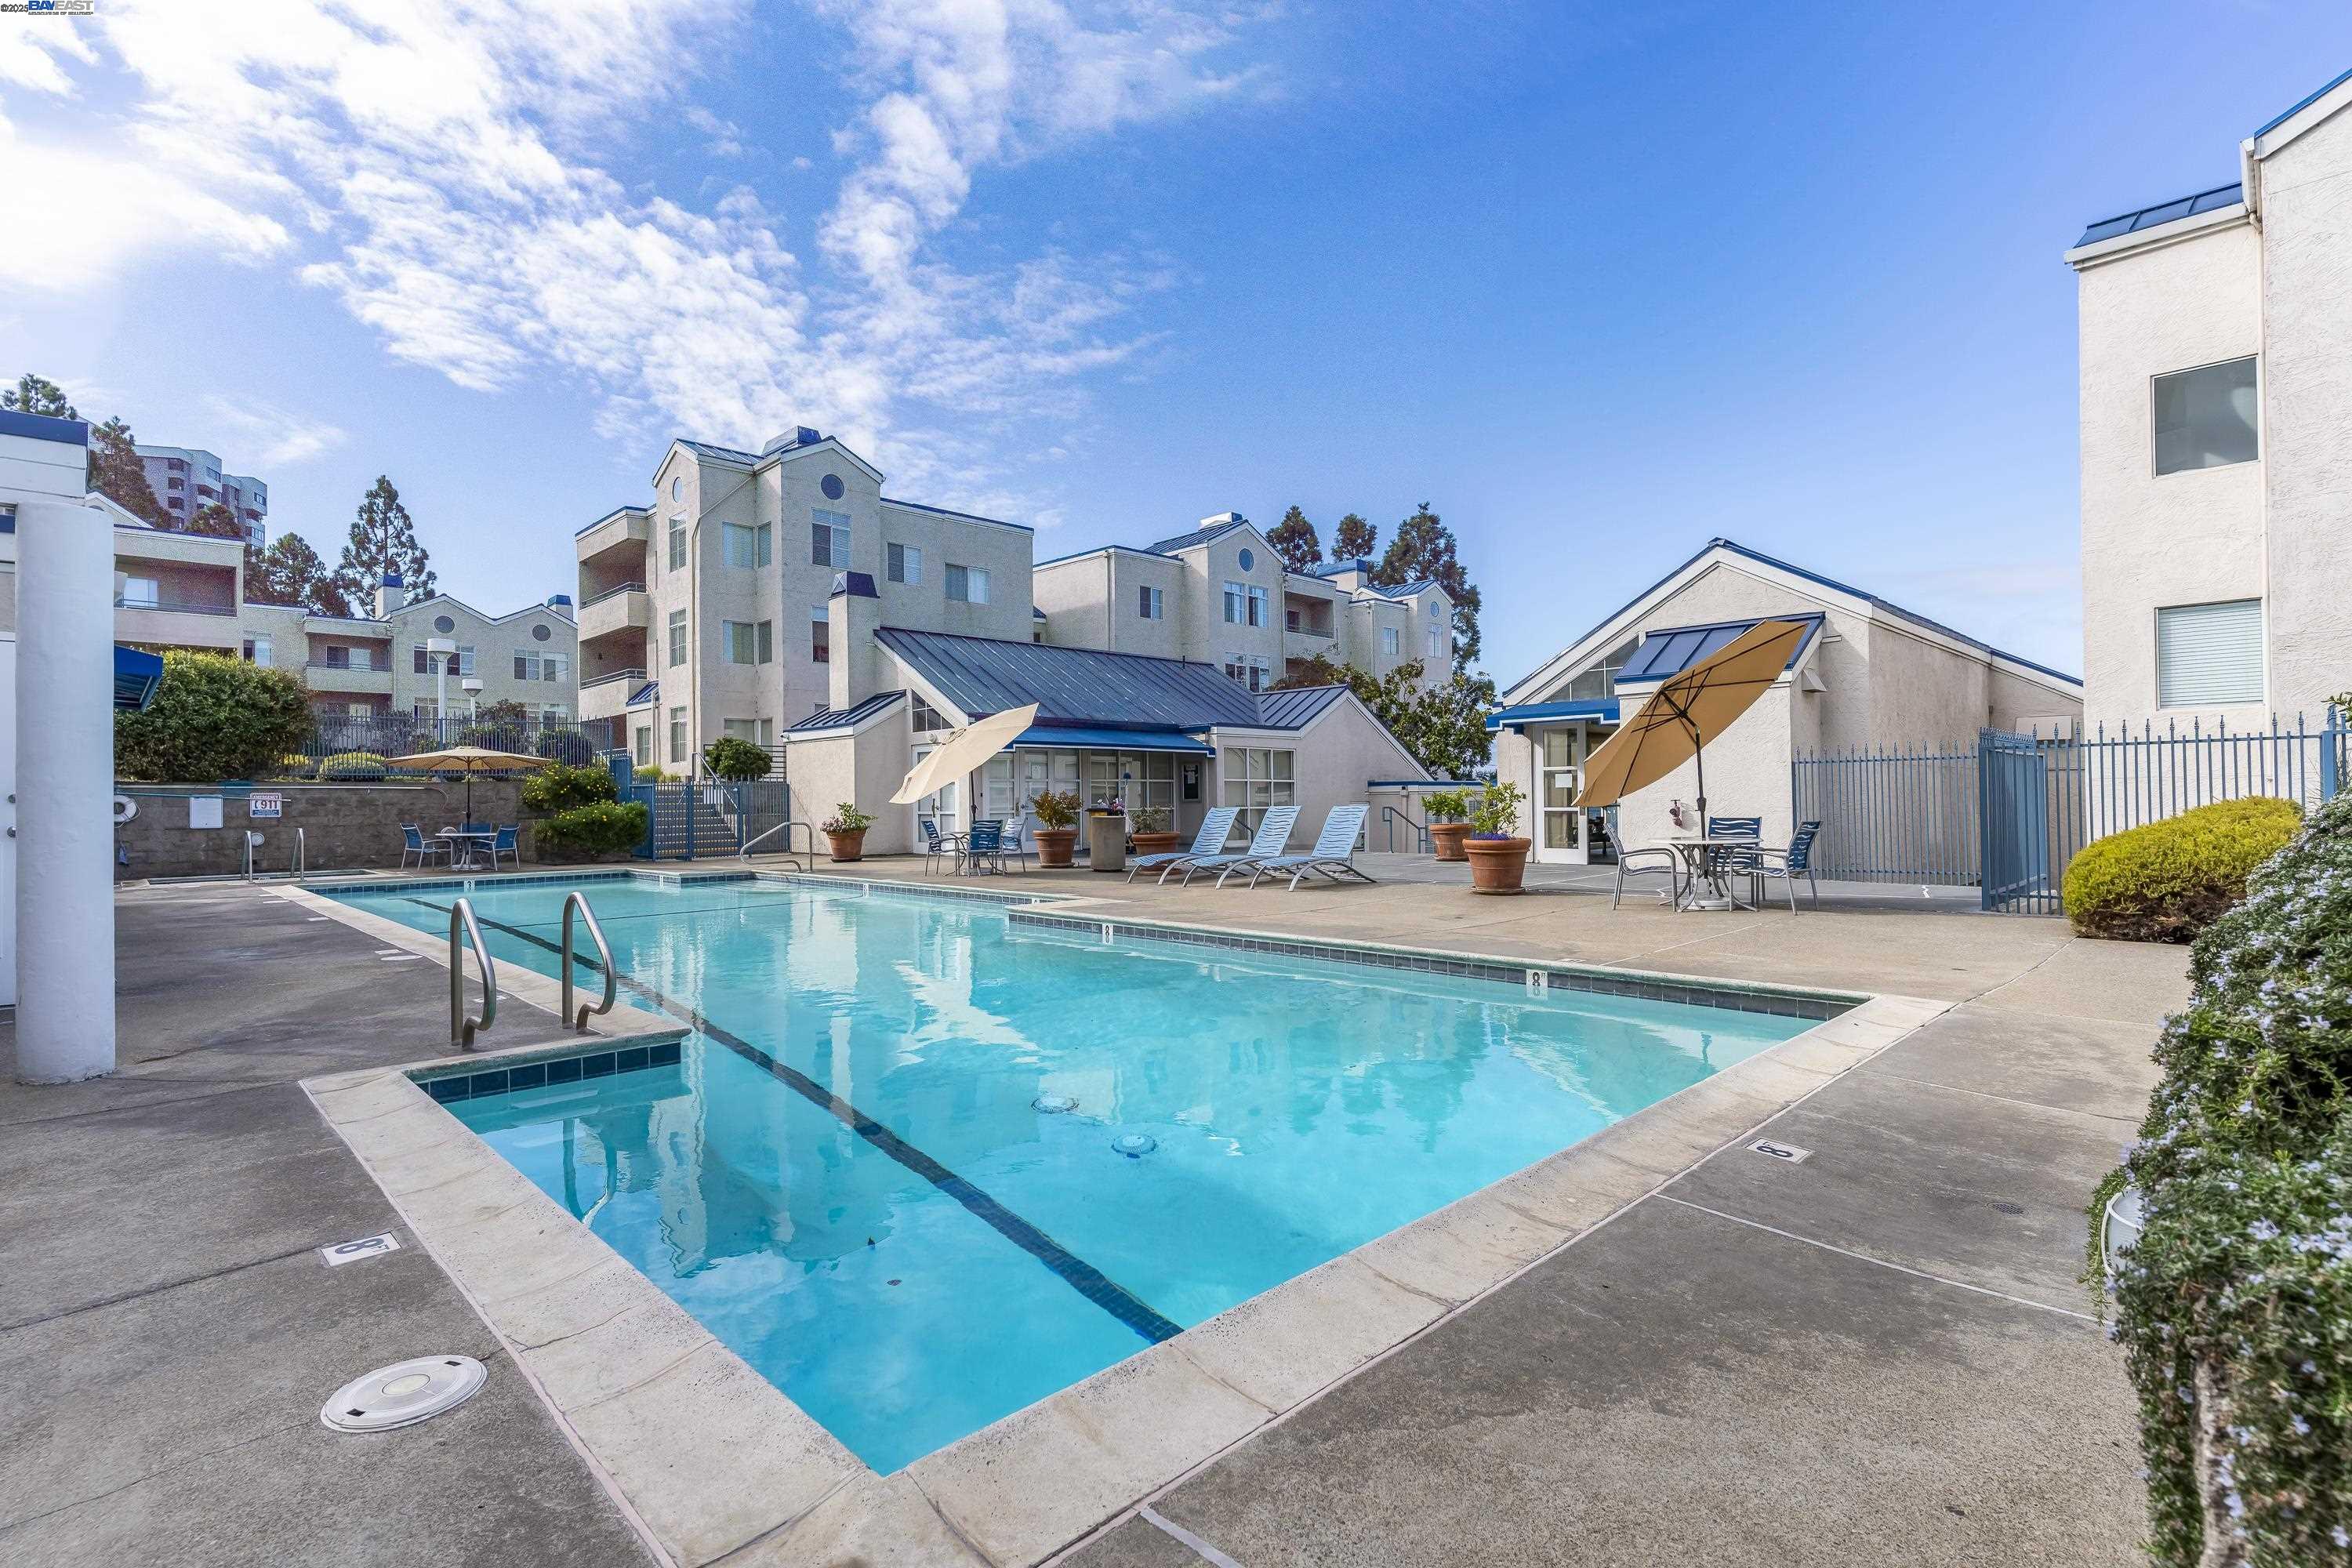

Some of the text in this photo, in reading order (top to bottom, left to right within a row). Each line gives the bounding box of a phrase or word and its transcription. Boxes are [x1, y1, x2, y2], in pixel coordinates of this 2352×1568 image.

[260, 800, 278, 808] 911
[1532, 971, 1541, 985] 8
[1756, 1145, 1794, 1158] 8
[334, 1238, 385, 1254] 8
